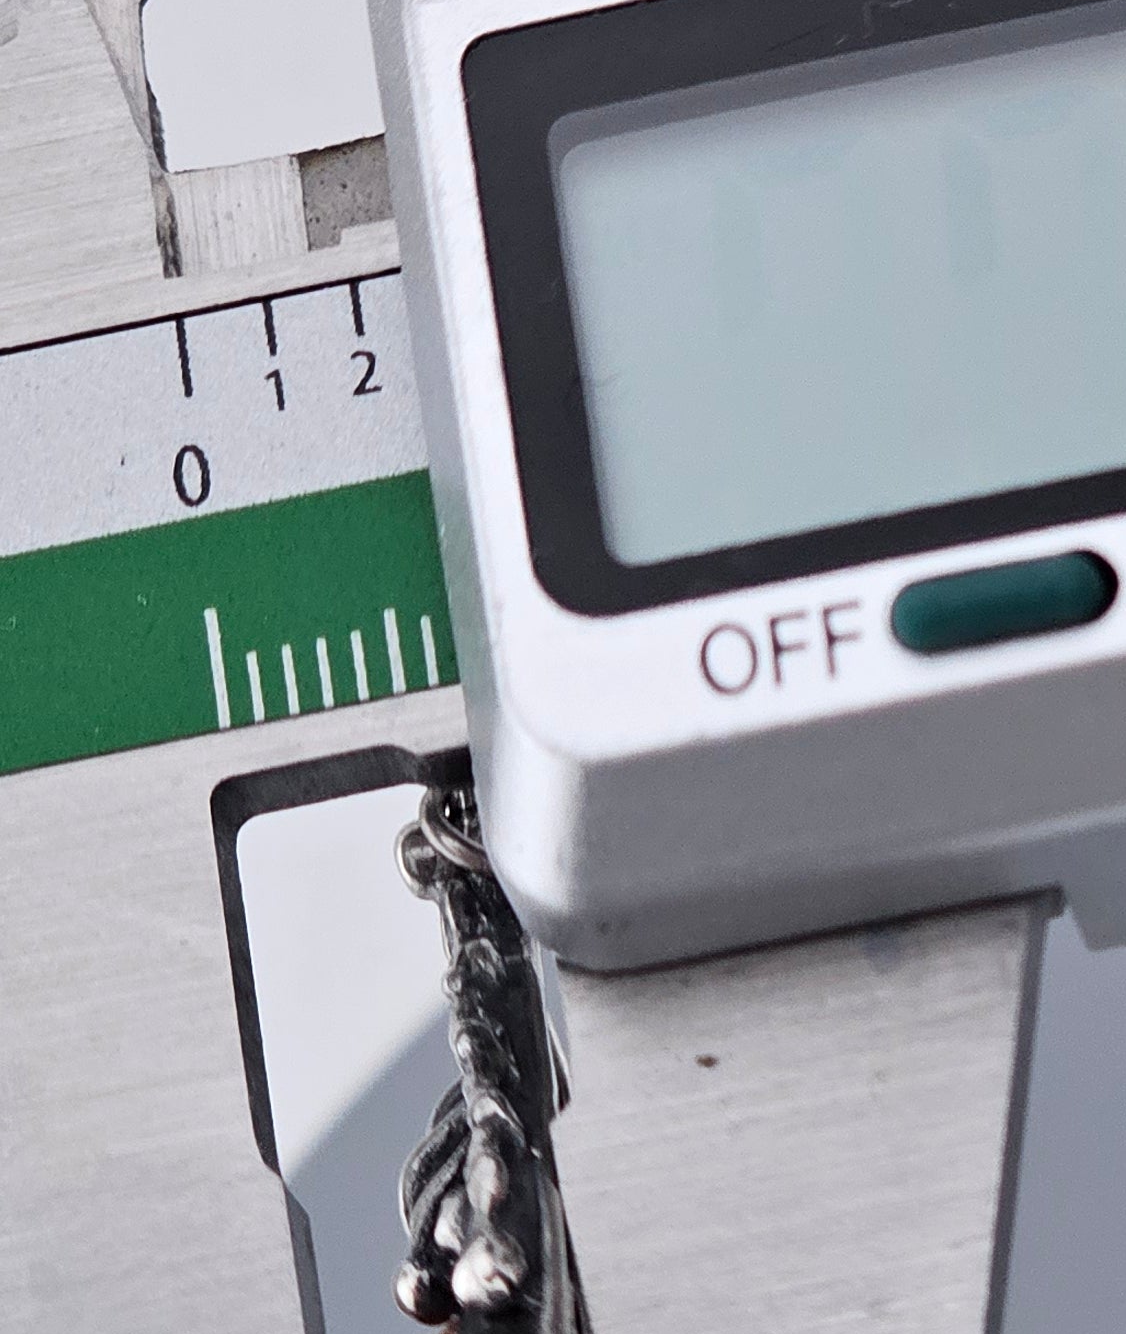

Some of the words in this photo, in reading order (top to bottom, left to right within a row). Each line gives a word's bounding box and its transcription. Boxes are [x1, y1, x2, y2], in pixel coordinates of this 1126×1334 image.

[172, 444, 211, 507] 0
[265, 369, 285, 411] 1
[350, 351, 382, 396] 2
[699, 600, 861, 696] OFF
